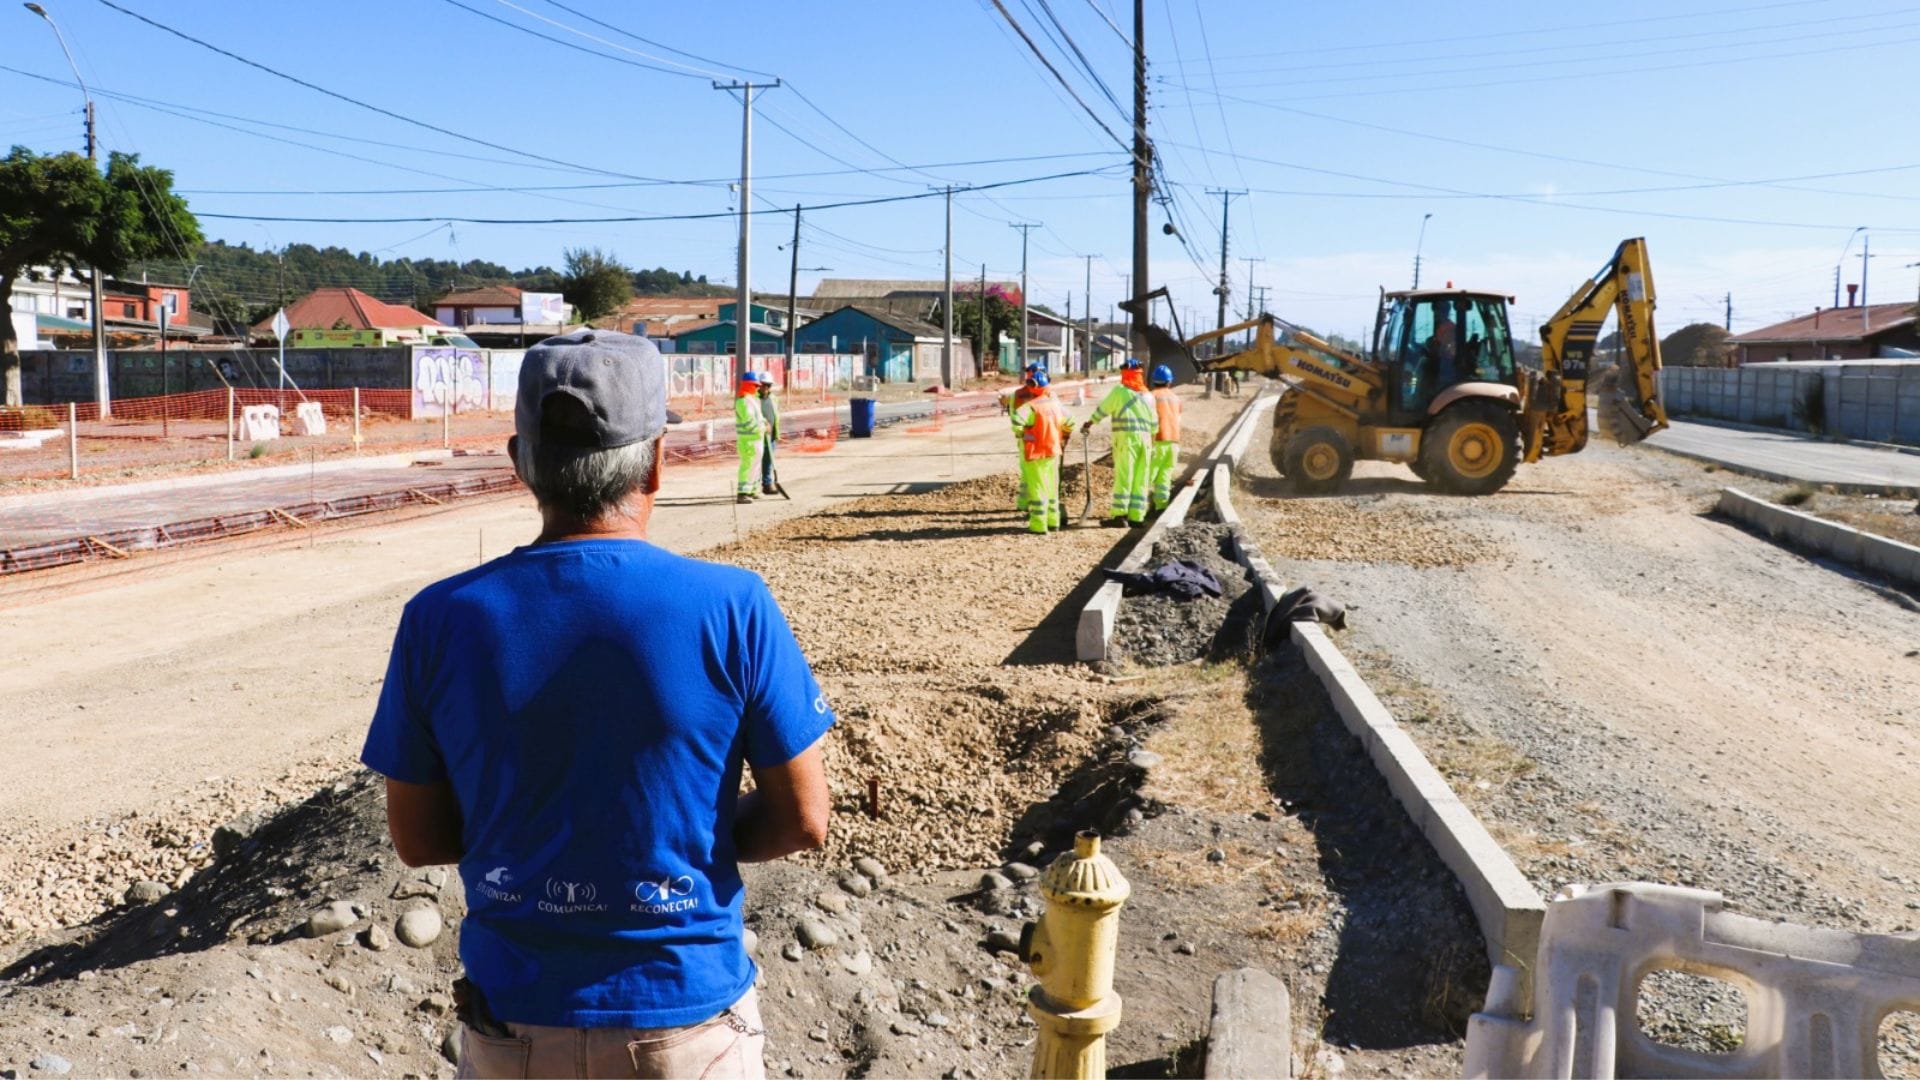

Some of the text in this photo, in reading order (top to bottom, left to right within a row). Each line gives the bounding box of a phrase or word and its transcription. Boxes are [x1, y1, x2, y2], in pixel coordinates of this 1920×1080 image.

[1620, 289, 1638, 338] KOMATSU
[1296, 359, 1352, 388] KOMATSU
[537, 899, 609, 914] COMUNICA!
[630, 897, 699, 914] RECONECTA!
